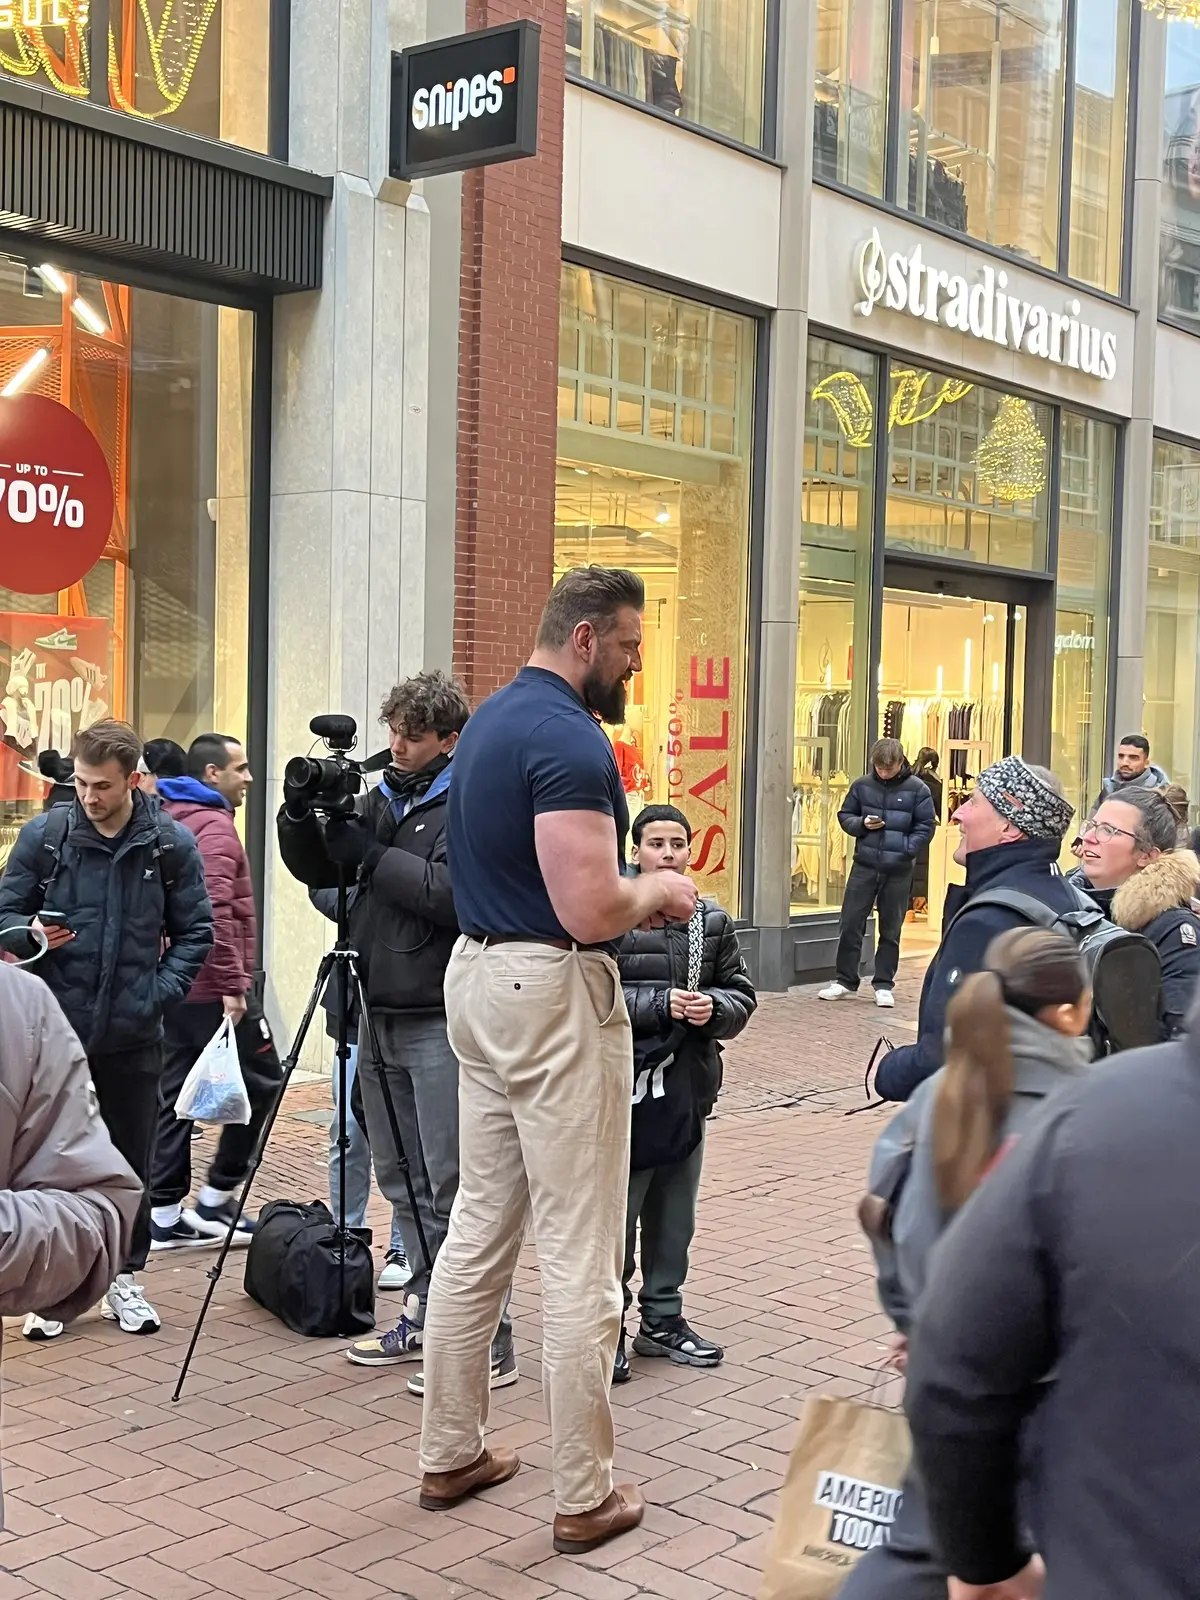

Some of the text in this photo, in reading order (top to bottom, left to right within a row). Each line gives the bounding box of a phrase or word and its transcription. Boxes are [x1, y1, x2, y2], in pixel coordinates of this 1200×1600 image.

[412, 70, 503, 131] snipes
[886, 244, 1117, 380] stradivarius
[16, 463, 48, 476] UP TO
[667, 688, 684, 805] TO 50%
[688, 655, 730, 877] SALE
